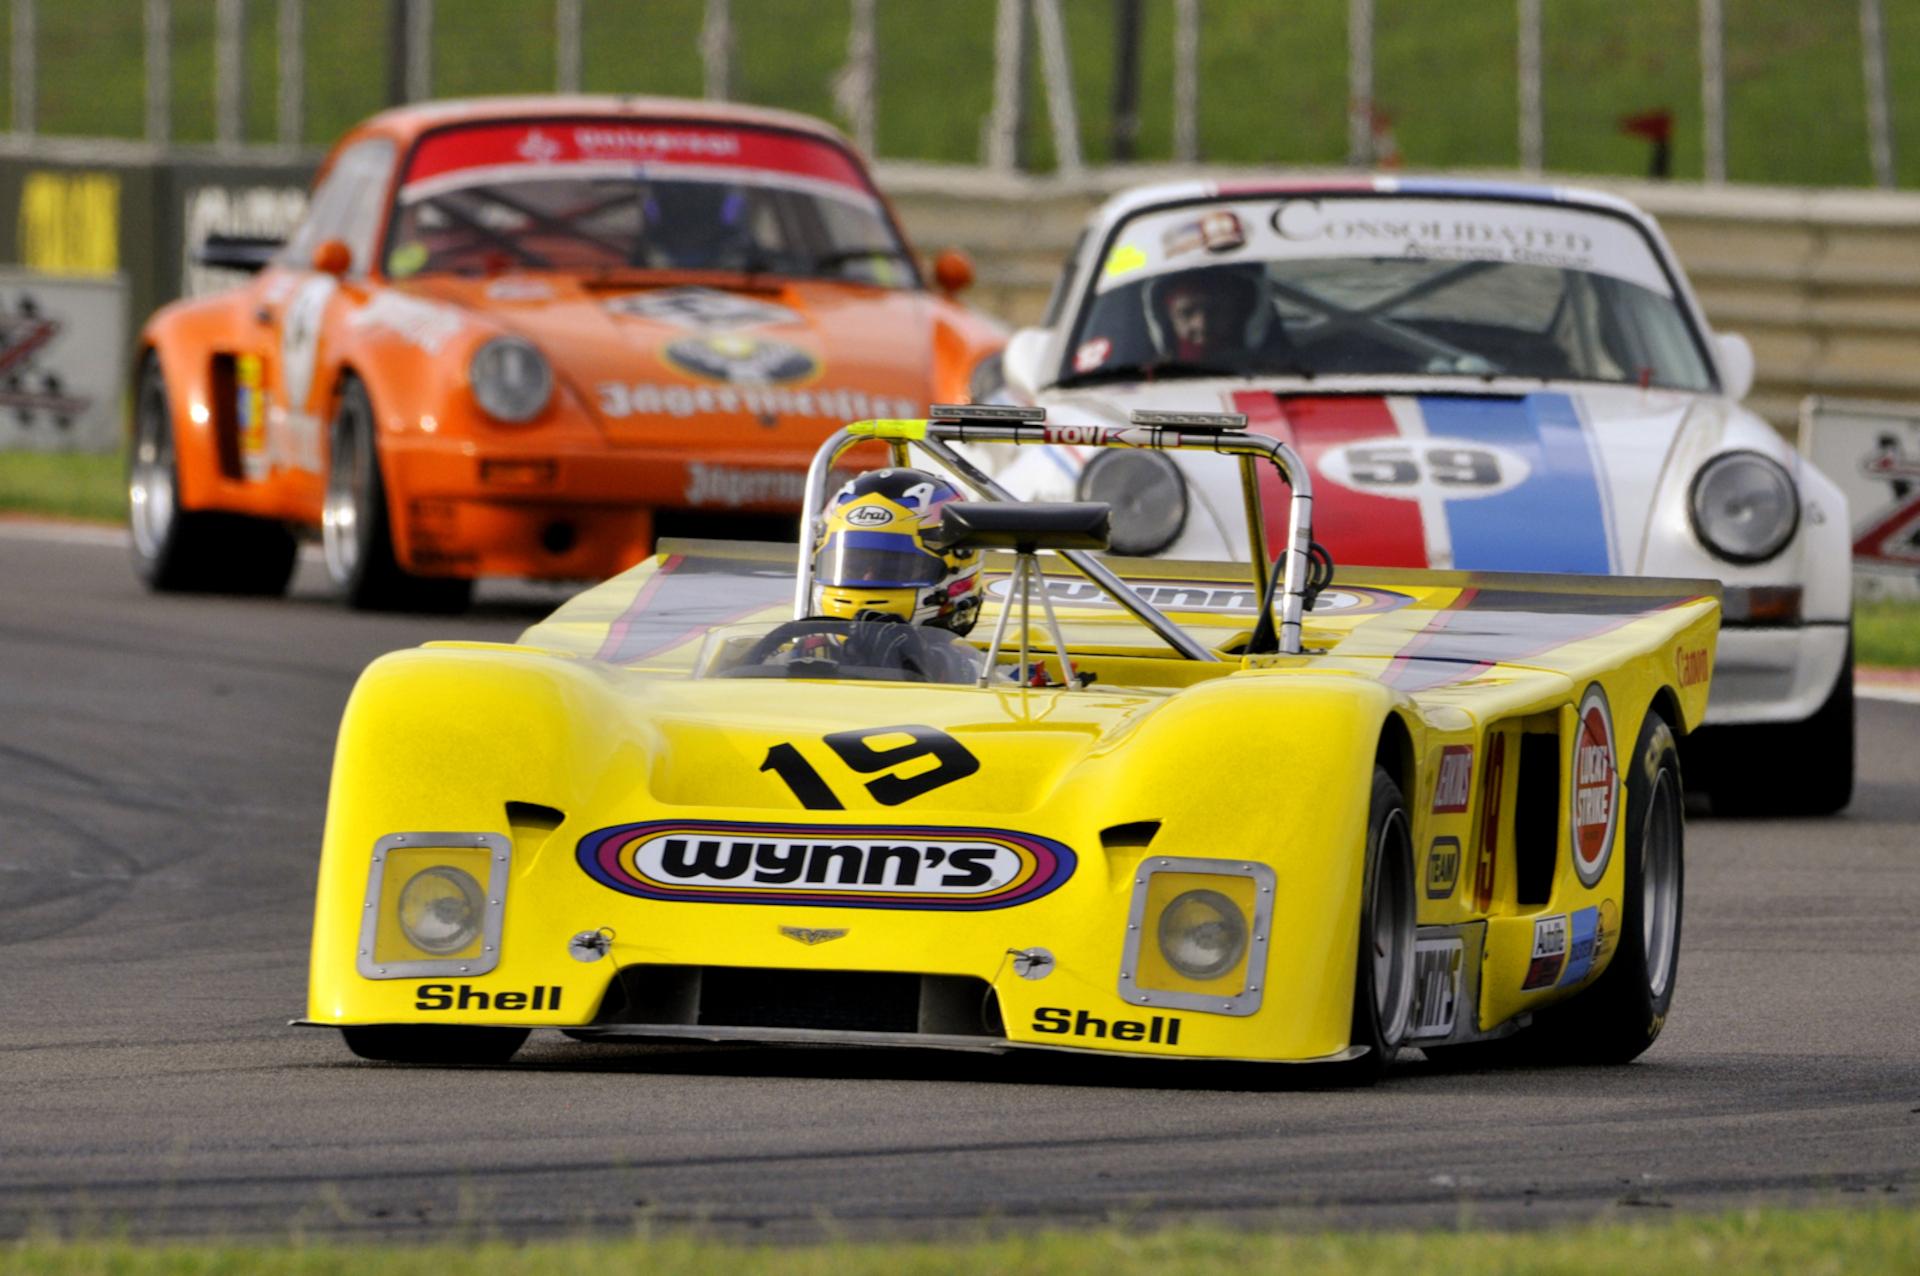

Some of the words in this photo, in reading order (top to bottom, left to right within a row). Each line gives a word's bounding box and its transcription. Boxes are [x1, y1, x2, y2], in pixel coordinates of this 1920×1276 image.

[1344, 447, 1502, 487] 59
[848, 506, 886, 520] Arai
[1676, 646, 1709, 689] Canon
[760, 725, 981, 811] 19
[1580, 745, 1608, 784] LUCKY
[1577, 785, 1609, 828] STRIKE
[1431, 853, 1456, 883] TEAM
[415, 984, 562, 1011] Shell
[1032, 1007, 1181, 1046] Shell
